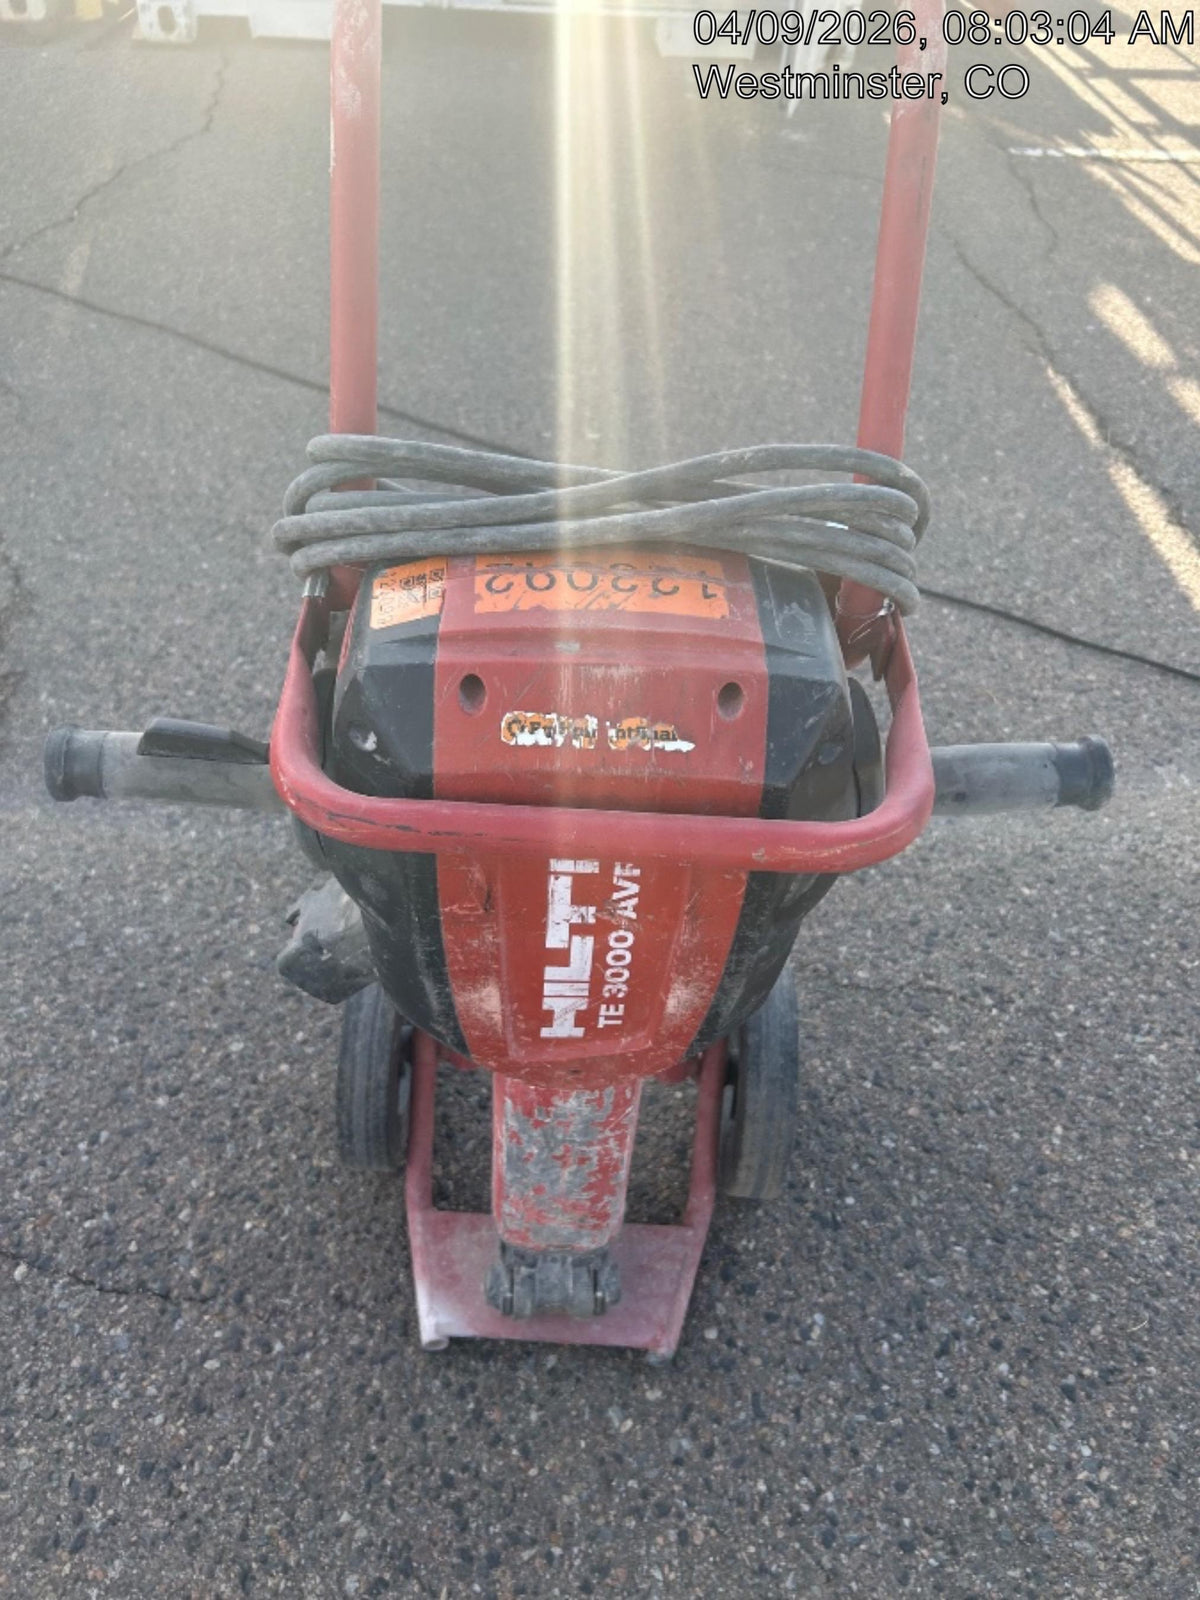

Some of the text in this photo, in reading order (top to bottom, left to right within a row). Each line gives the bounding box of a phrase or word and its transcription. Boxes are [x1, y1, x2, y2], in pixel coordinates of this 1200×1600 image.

[541, 858, 600, 1038] HILTI
[604, 929, 635, 999] 3000
[598, 1003, 625, 1028] TE
